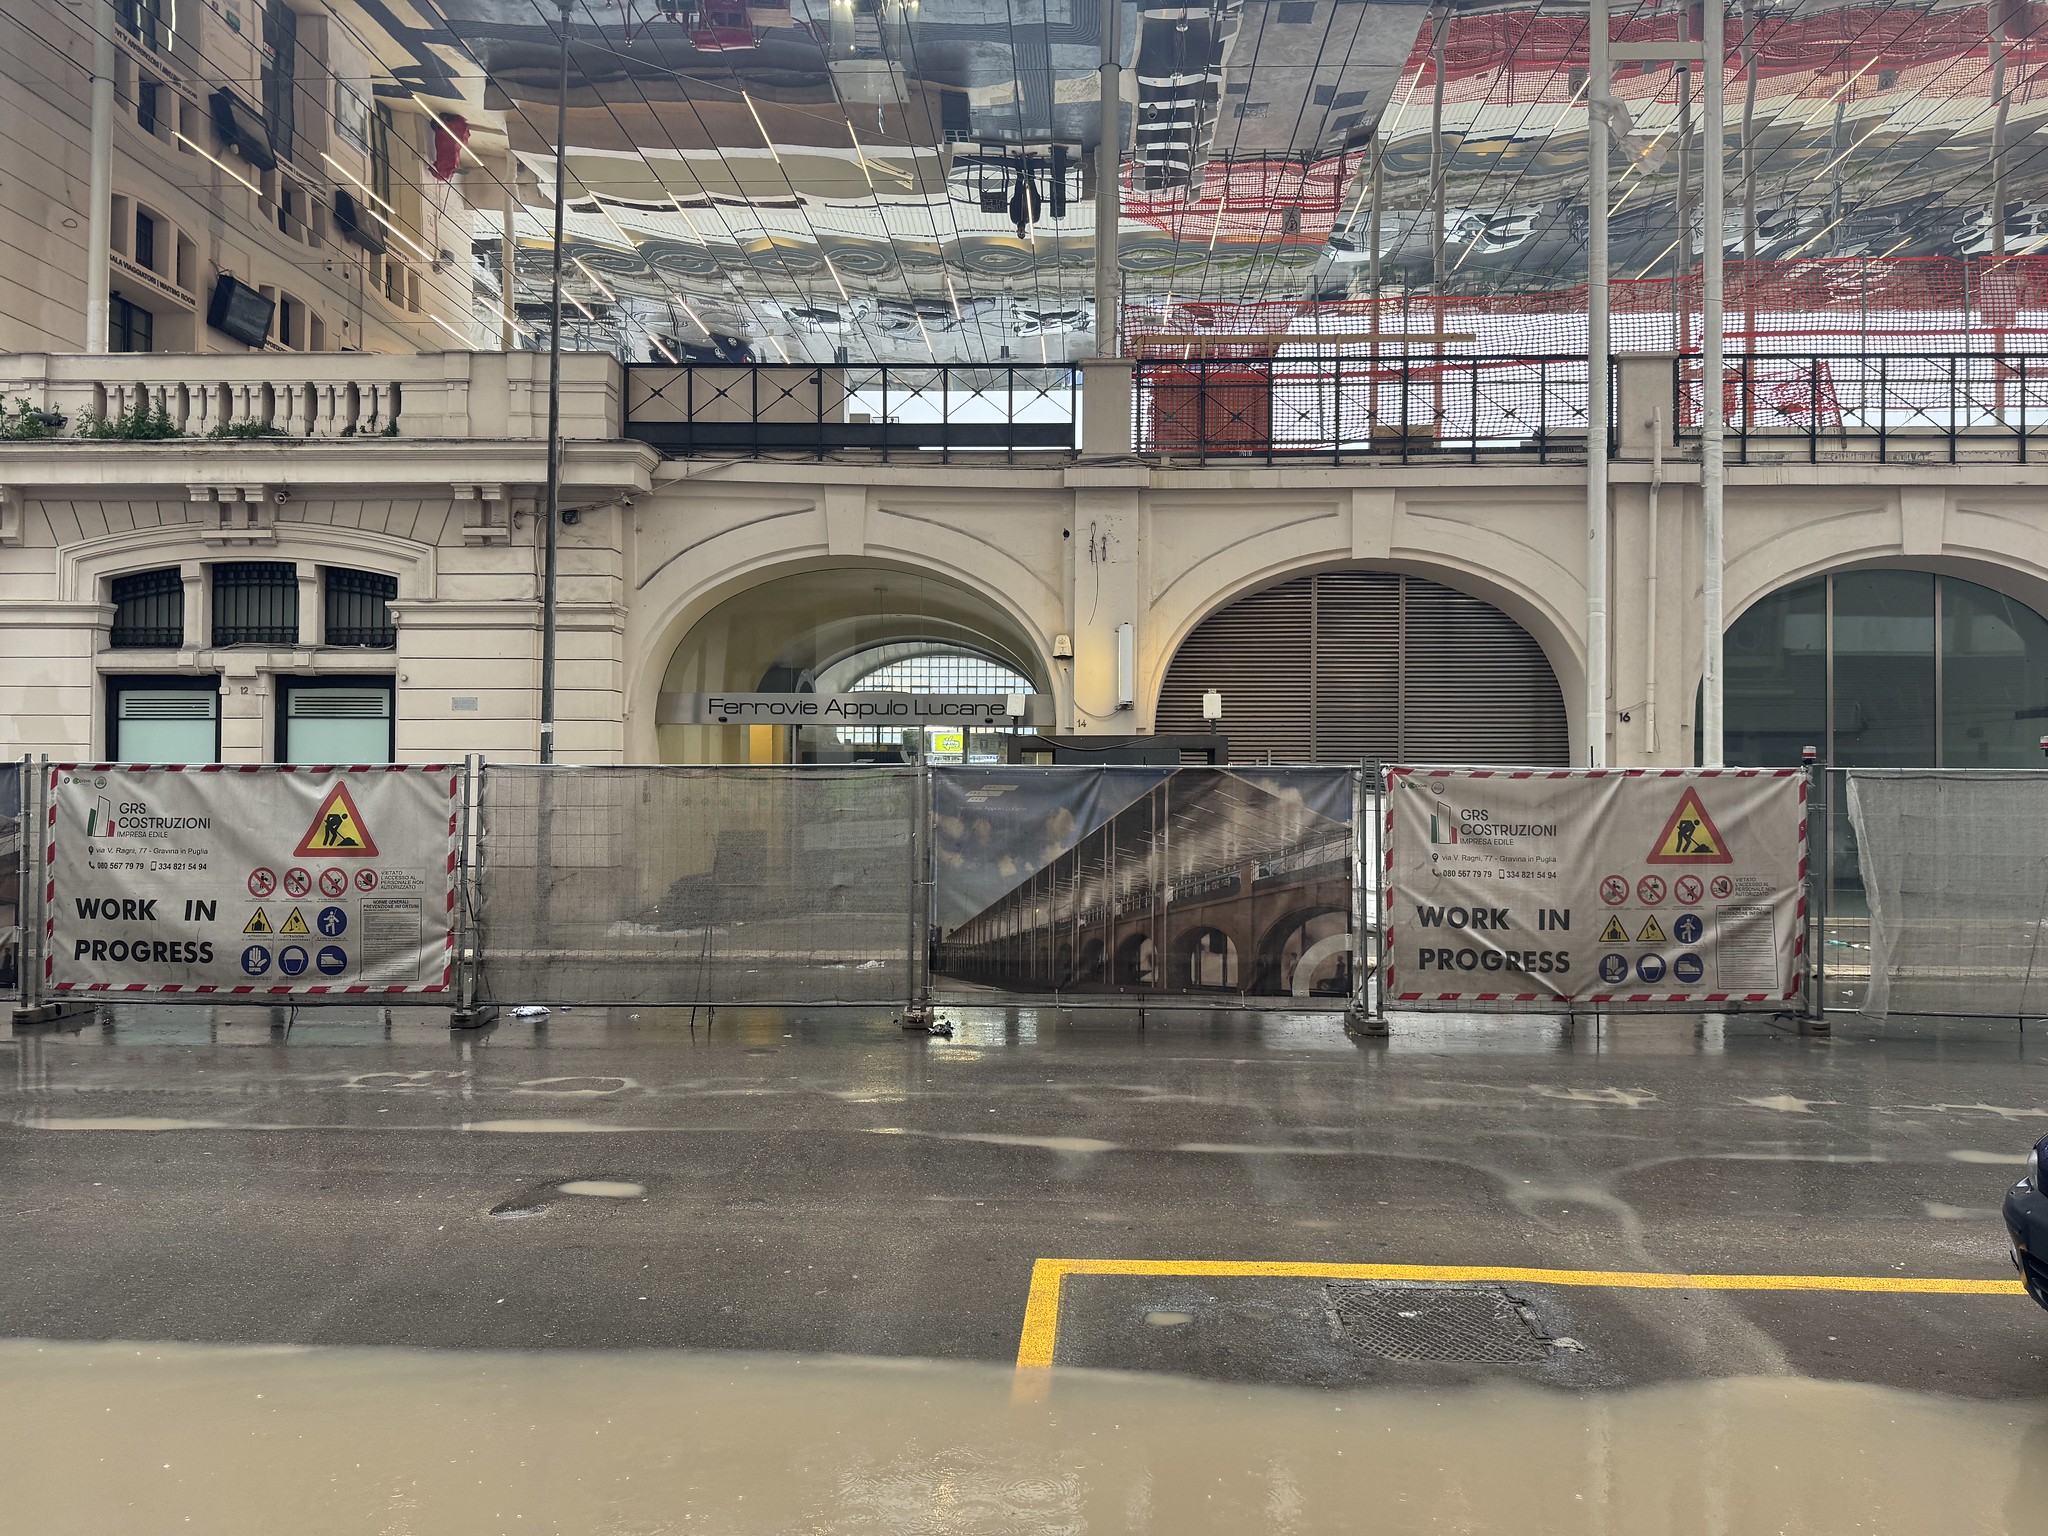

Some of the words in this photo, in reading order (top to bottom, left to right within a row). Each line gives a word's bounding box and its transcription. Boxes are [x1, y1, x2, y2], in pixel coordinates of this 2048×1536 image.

[123, 261, 156, 285] VIAGGIATORI
[160, 281, 180, 297] WAITING
[181, 293, 195, 305] ROOM
[240, 687, 249, 695] 12
[708, 698, 818, 715] Ferrovie
[824, 698, 908, 720] Appulo
[914, 698, 1005, 716] Lucane
[1619, 712, 1631, 723] 16
[1077, 719, 1087, 728] 14
[119, 802, 147, 815] GRS
[1460, 809, 1489, 821] GRS
[118, 817, 211, 829] COSTRUZIONI
[1460, 824, 1557, 837] COSTRUZIONI
[1494, 838, 1514, 846] EDILE
[187, 848, 209, 856] Puglia
[1462, 855, 1483, 863] Ragni,
[1499, 855, 1527, 863] Gravina
[1536, 856, 1557, 864] Puglia
[136, 862, 144, 870] 79
[188, 863, 197, 871] 54
[198, 863, 207, 871] 94
[1442, 869, 1456, 877] 080
[1458, 869, 1471, 877] 567
[1473, 870, 1482, 878] 79
[1483, 870, 1492, 878] 79
[1521, 871, 1535, 879] 821
[1537, 871, 1546, 879] 54
[75, 898, 158, 920] WORK
[184, 899, 217, 921] IN
[1416, 906, 1510, 930] WORK
[1538, 908, 1570, 931] IN
[74, 939, 214, 964] PROGRESS
[1418, 948, 1570, 973] PROGRESS
